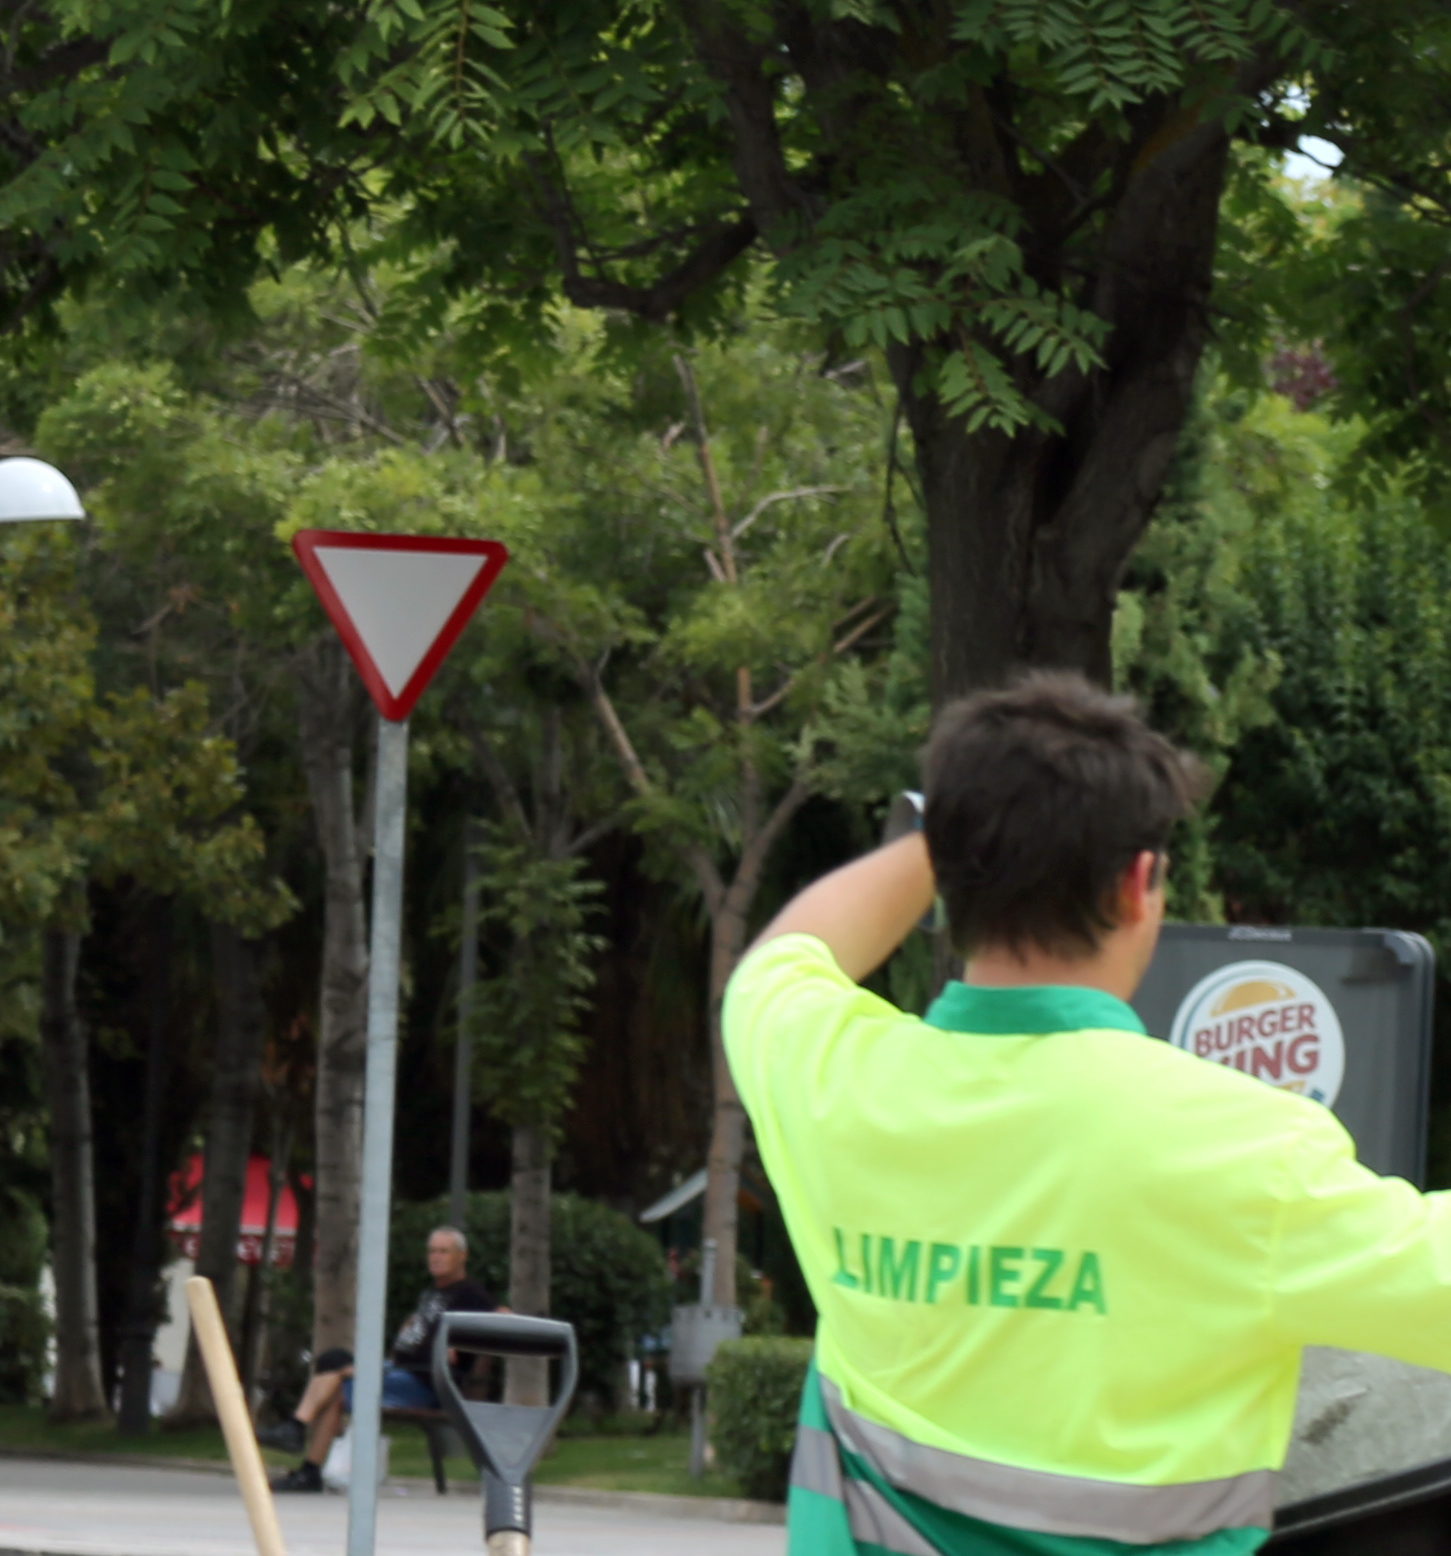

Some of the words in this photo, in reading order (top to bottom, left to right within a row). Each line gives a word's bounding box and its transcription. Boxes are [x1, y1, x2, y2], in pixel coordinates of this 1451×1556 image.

[1194, 1003, 1316, 1058] BURGER
[1218, 1034, 1320, 1081] ING
[831, 1226, 1107, 1316] LIMPIEZA
